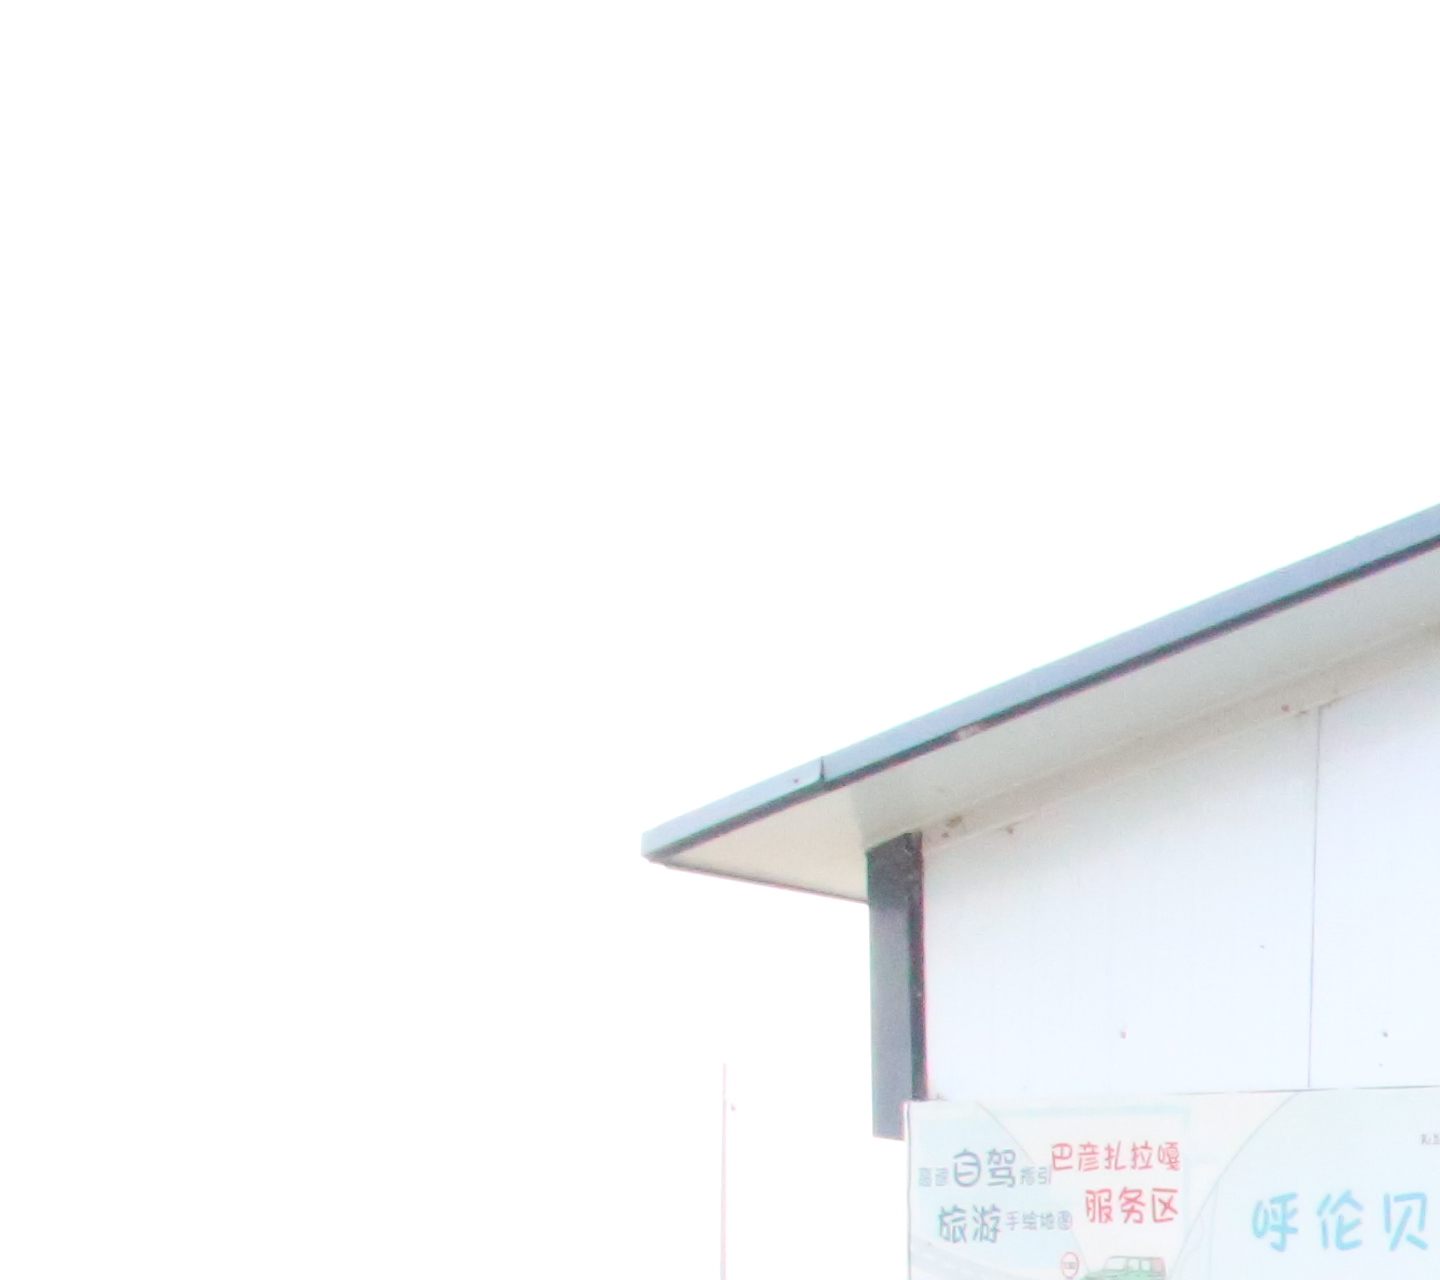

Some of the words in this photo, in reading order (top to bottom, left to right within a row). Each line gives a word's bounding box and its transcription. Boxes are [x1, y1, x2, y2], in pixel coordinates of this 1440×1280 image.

[1050, 1139, 1181, 1173] 巴彦扎拉嘎
[937, 1203, 1074, 1244] 旅游手绘地图
[1084, 1185, 1180, 1225] 服务区
